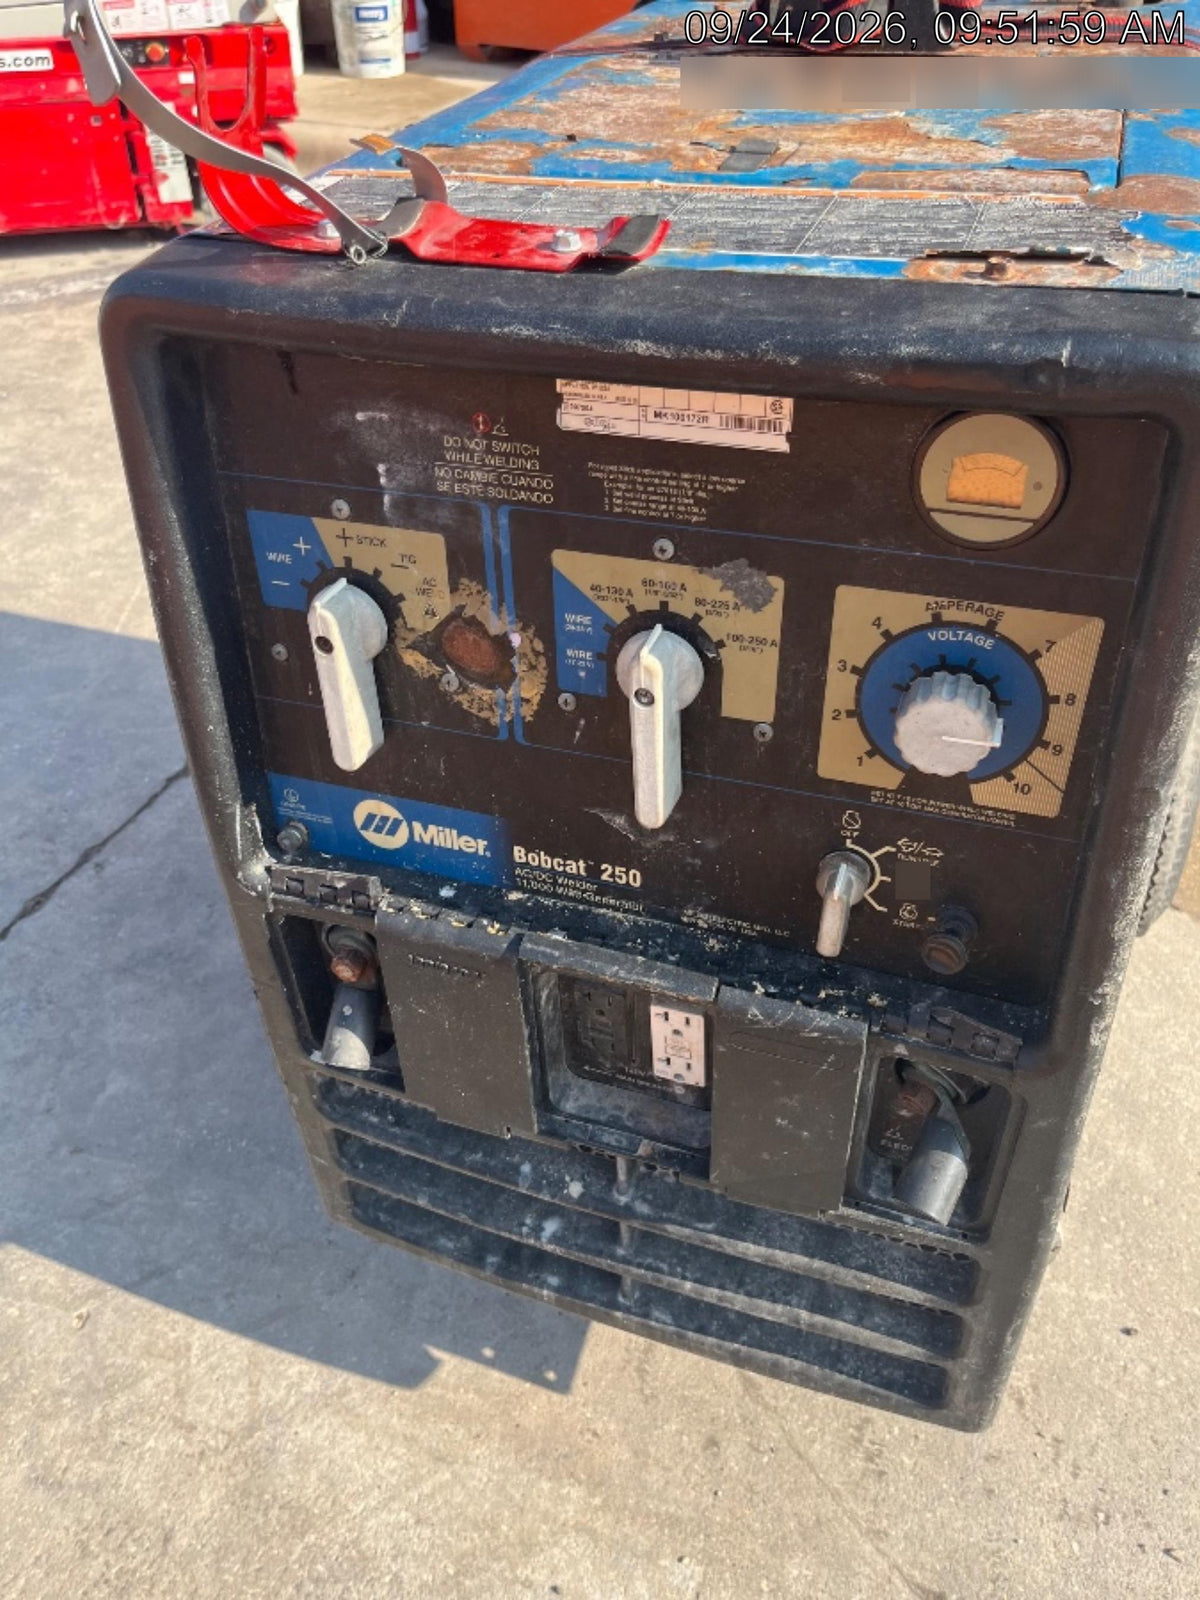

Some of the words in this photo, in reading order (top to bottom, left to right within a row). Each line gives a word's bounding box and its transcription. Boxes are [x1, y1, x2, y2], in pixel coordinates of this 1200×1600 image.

[443, 435, 461, 447] DO
[464, 438, 488, 450] NOT
[491, 440, 540, 456] SWITCH
[444, 450, 483, 465] WHILE
[484, 454, 540, 470] WELDING
[434, 466, 452, 478] NO
[454, 469, 498, 485] CAMBIE
[501, 474, 554, 490] CUANDO
[436, 481, 452, 492] SE
[487, 487, 554, 504] SOLDANDO
[356, 534, 388, 548] STICK
[265, 551, 293, 565] WIRE
[626, 587, 634, 598] A
[677, 582, 687, 592] A
[925, 600, 1006, 622] AMPERAGE
[564, 613, 593, 625] WIRE
[871, 616, 883, 630] 4
[768, 639, 778, 649] A
[927, 630, 996, 650] VOLTAGE
[1045, 640, 1056, 653] 7
[566, 648, 593, 660] WIRE
[837, 659, 848, 672] 3
[1065, 693, 1077, 706] 8
[831, 709, 842, 721] 2
[1051, 744, 1063, 756] 9
[856, 756, 864, 766] 1
[1014, 781, 1031, 795] 10
[411, 820, 487, 856] Miller
[512, 845, 588, 876] Bobcat
[600, 863, 642, 888] 250
[514, 867, 554, 883] AC/DC
[556, 875, 599, 892] Welder
[514, 877, 554, 893] 11,000
